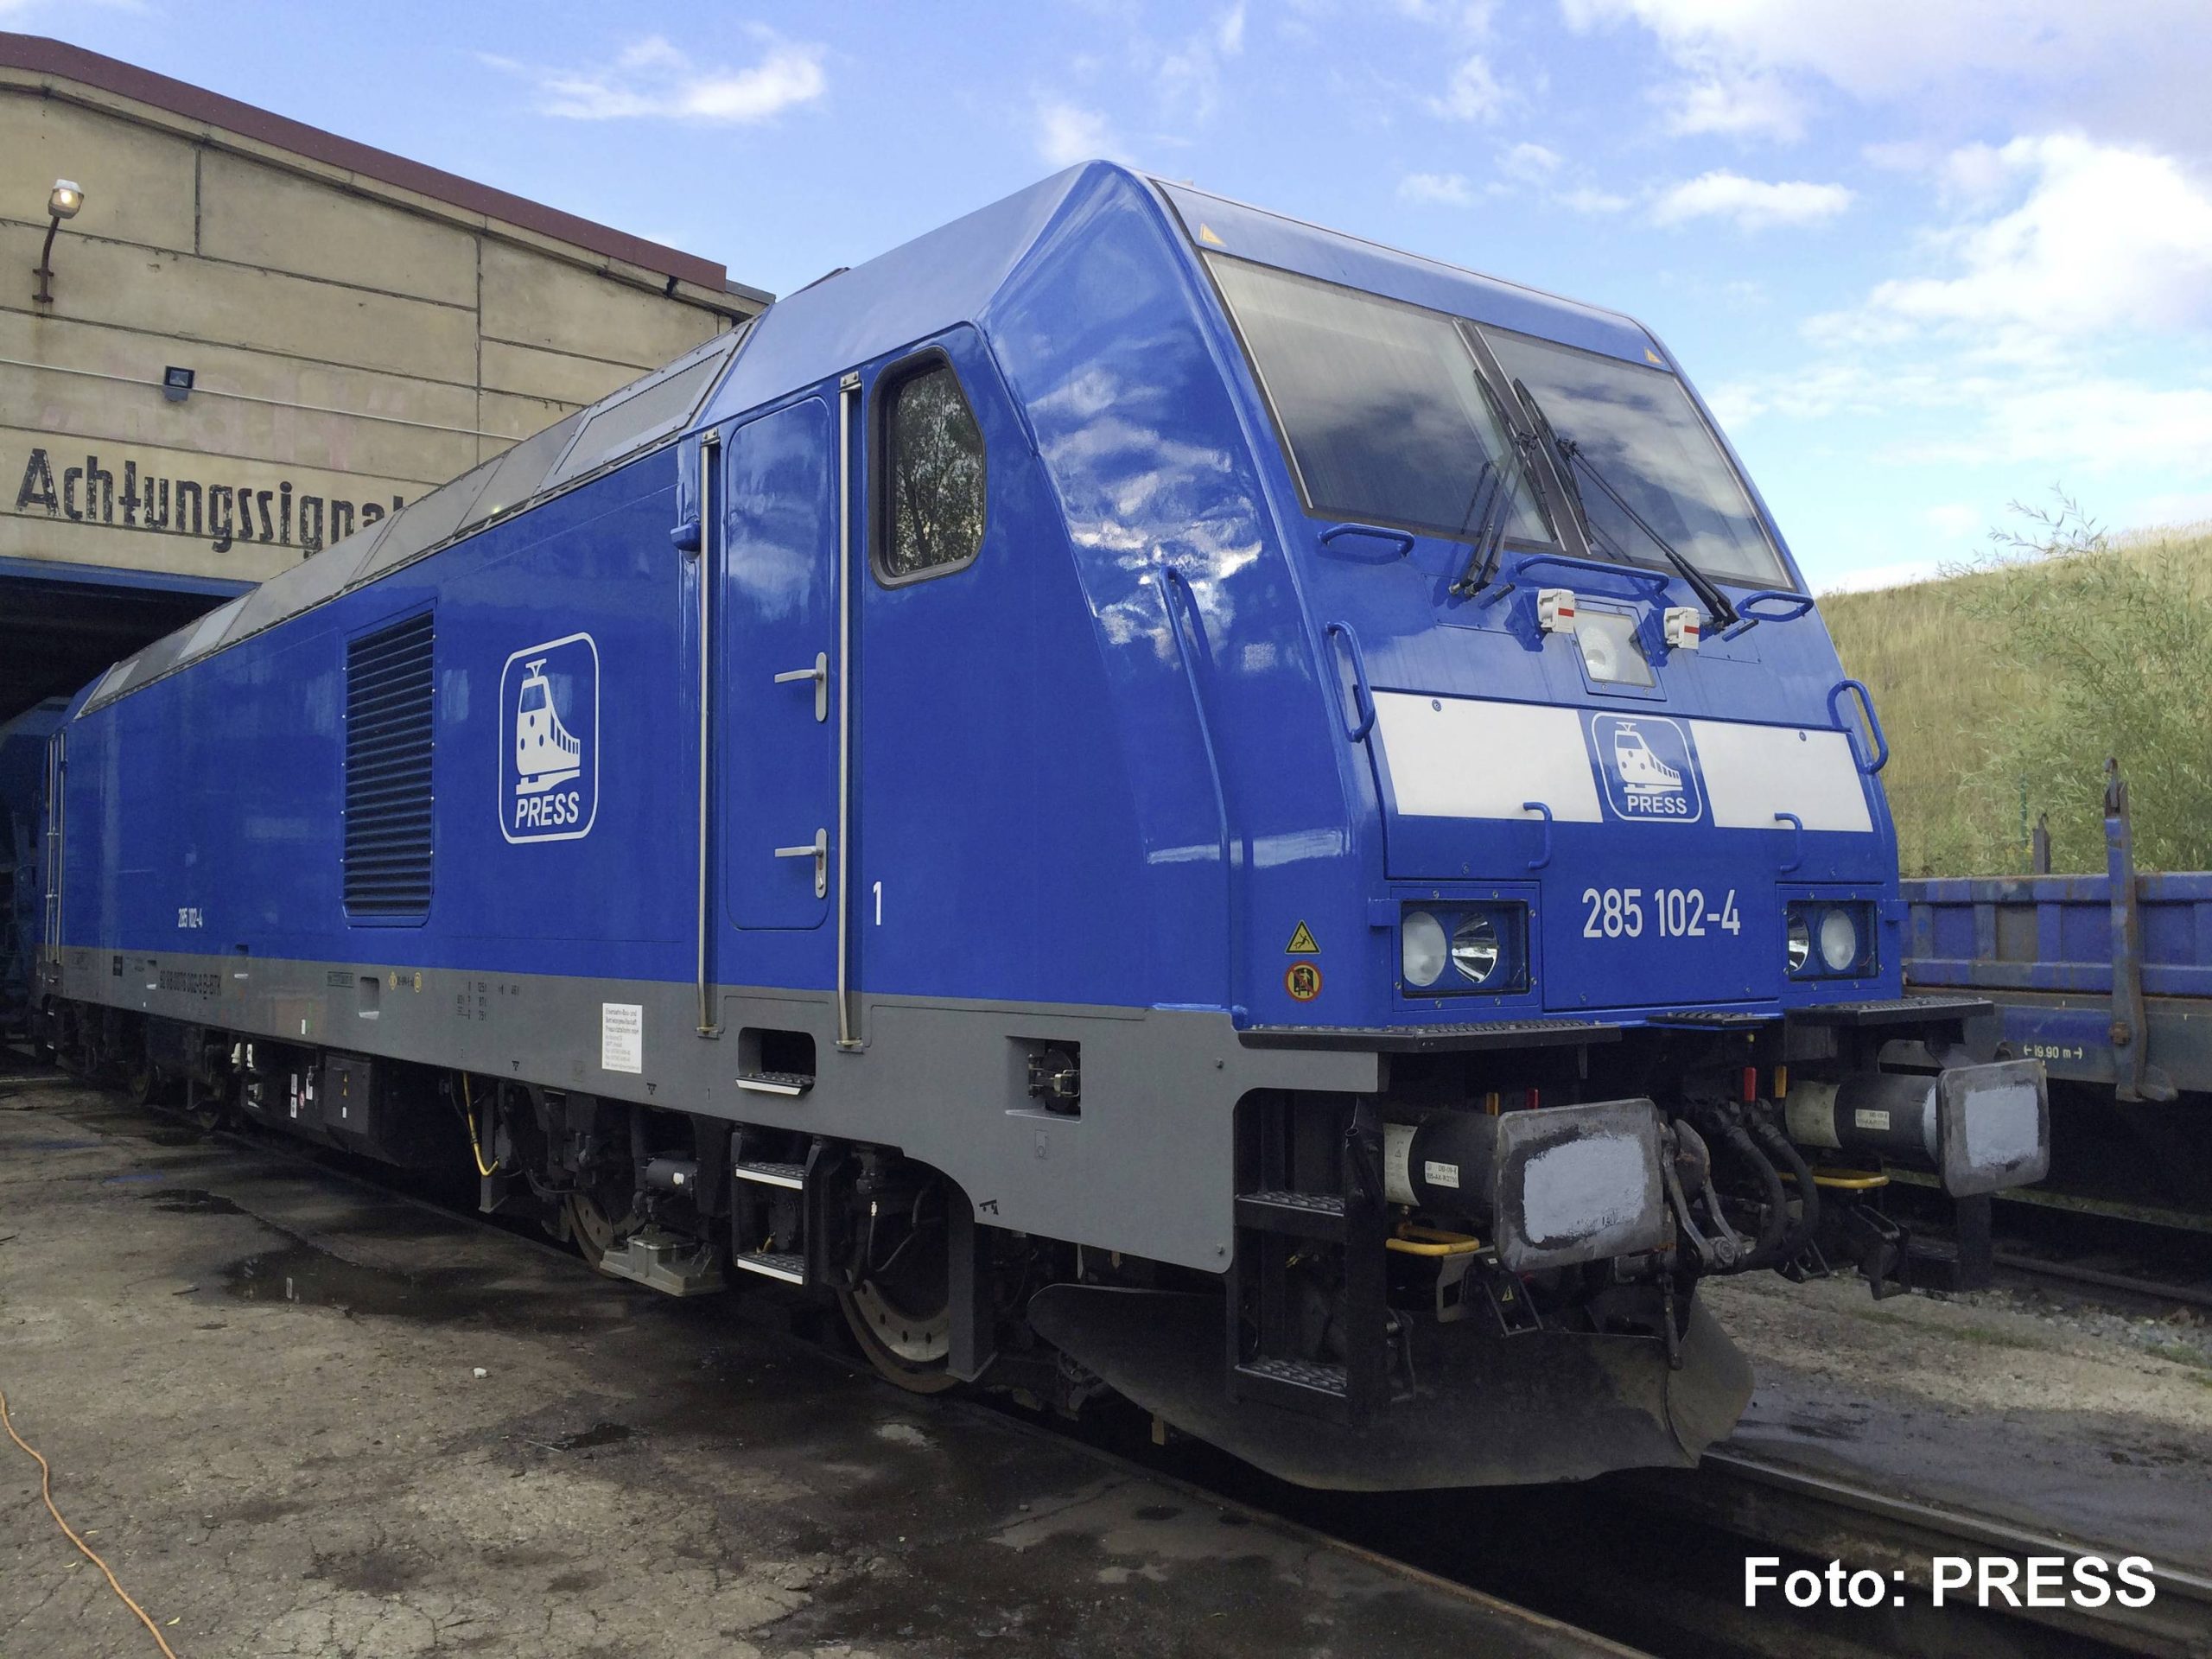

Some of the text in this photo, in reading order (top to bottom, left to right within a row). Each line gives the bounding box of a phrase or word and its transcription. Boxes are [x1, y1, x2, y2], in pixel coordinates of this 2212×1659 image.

[15, 448, 404, 559] Achtungssign
[515, 791, 581, 829] PRESS
[1627, 795, 1688, 815] PRESS
[873, 881, 882, 925] 1
[1582, 888, 1741, 938] 285 102-4
[2034, 1045, 2071, 1058] 19.90 m
